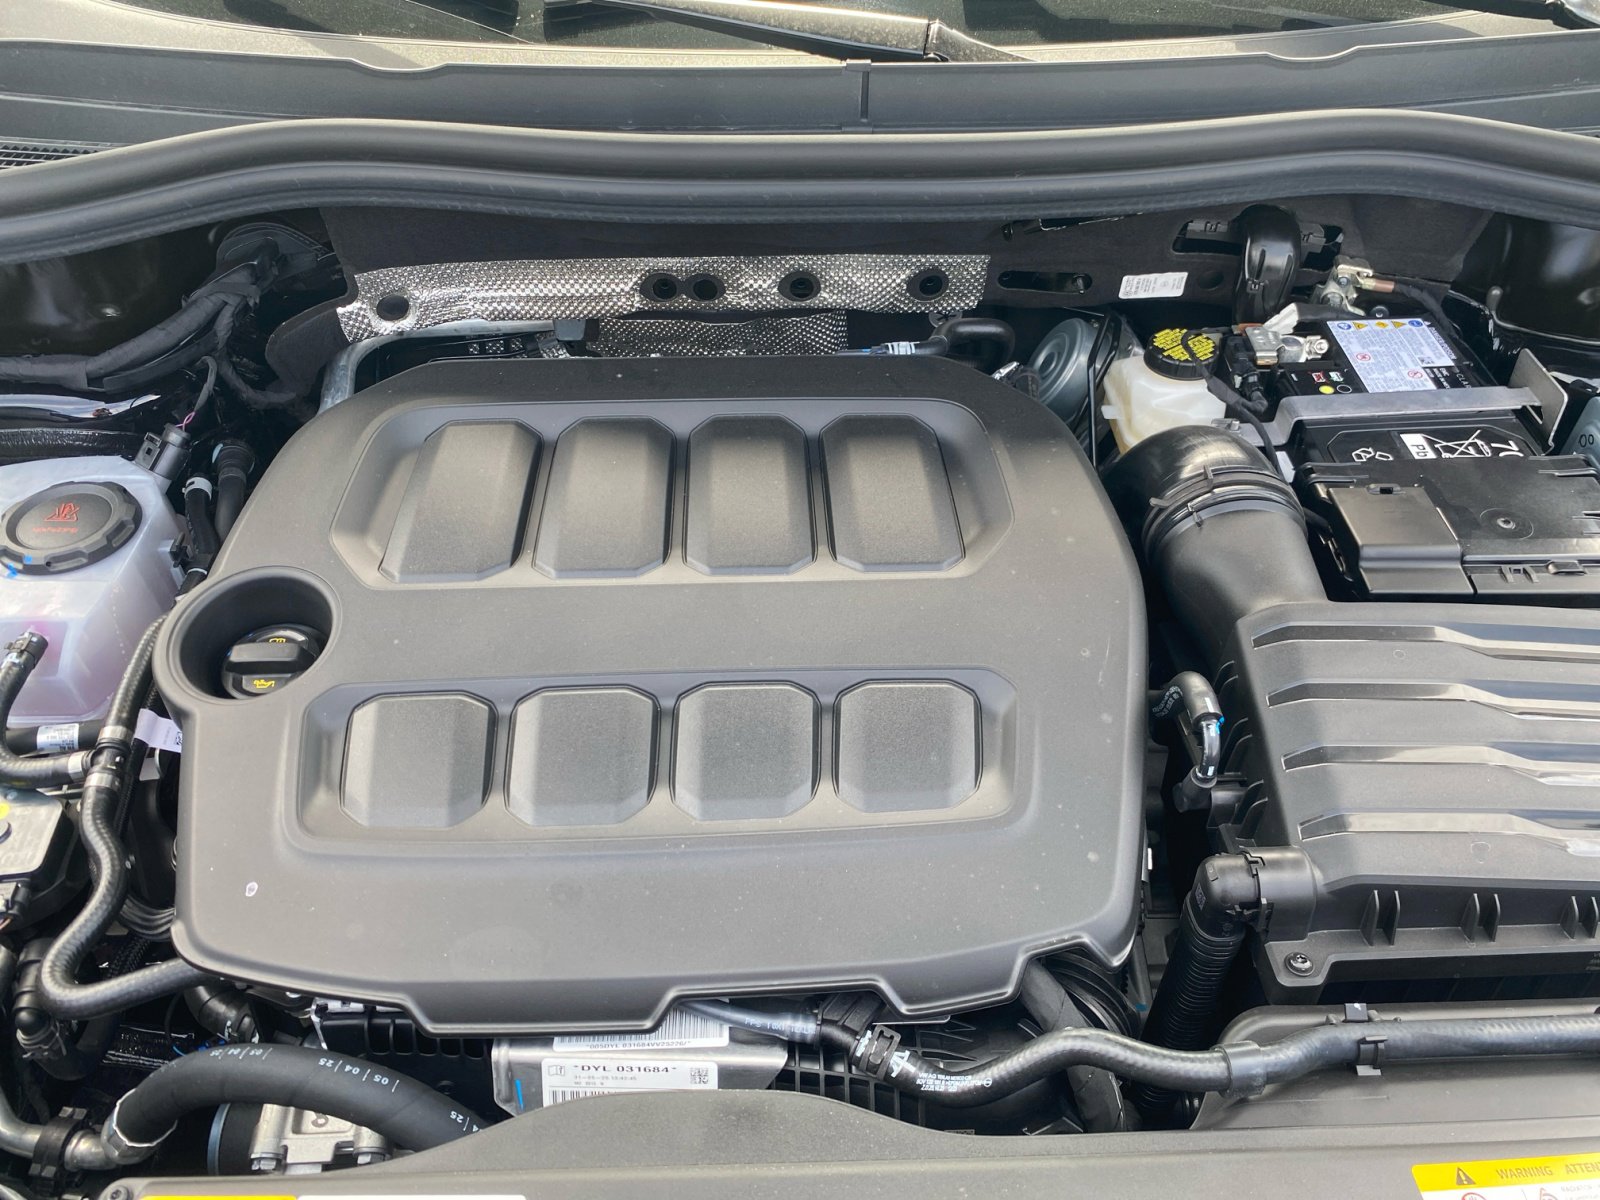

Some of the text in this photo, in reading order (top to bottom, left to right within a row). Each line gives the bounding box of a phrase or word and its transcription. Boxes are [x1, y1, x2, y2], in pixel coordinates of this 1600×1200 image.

[1410, 443, 1429, 458] Pb
[318, 1057, 389, 1085] 05 04 25
[450, 1110, 464, 1123] 25
[1496, 1166, 1553, 1179] WARNING
